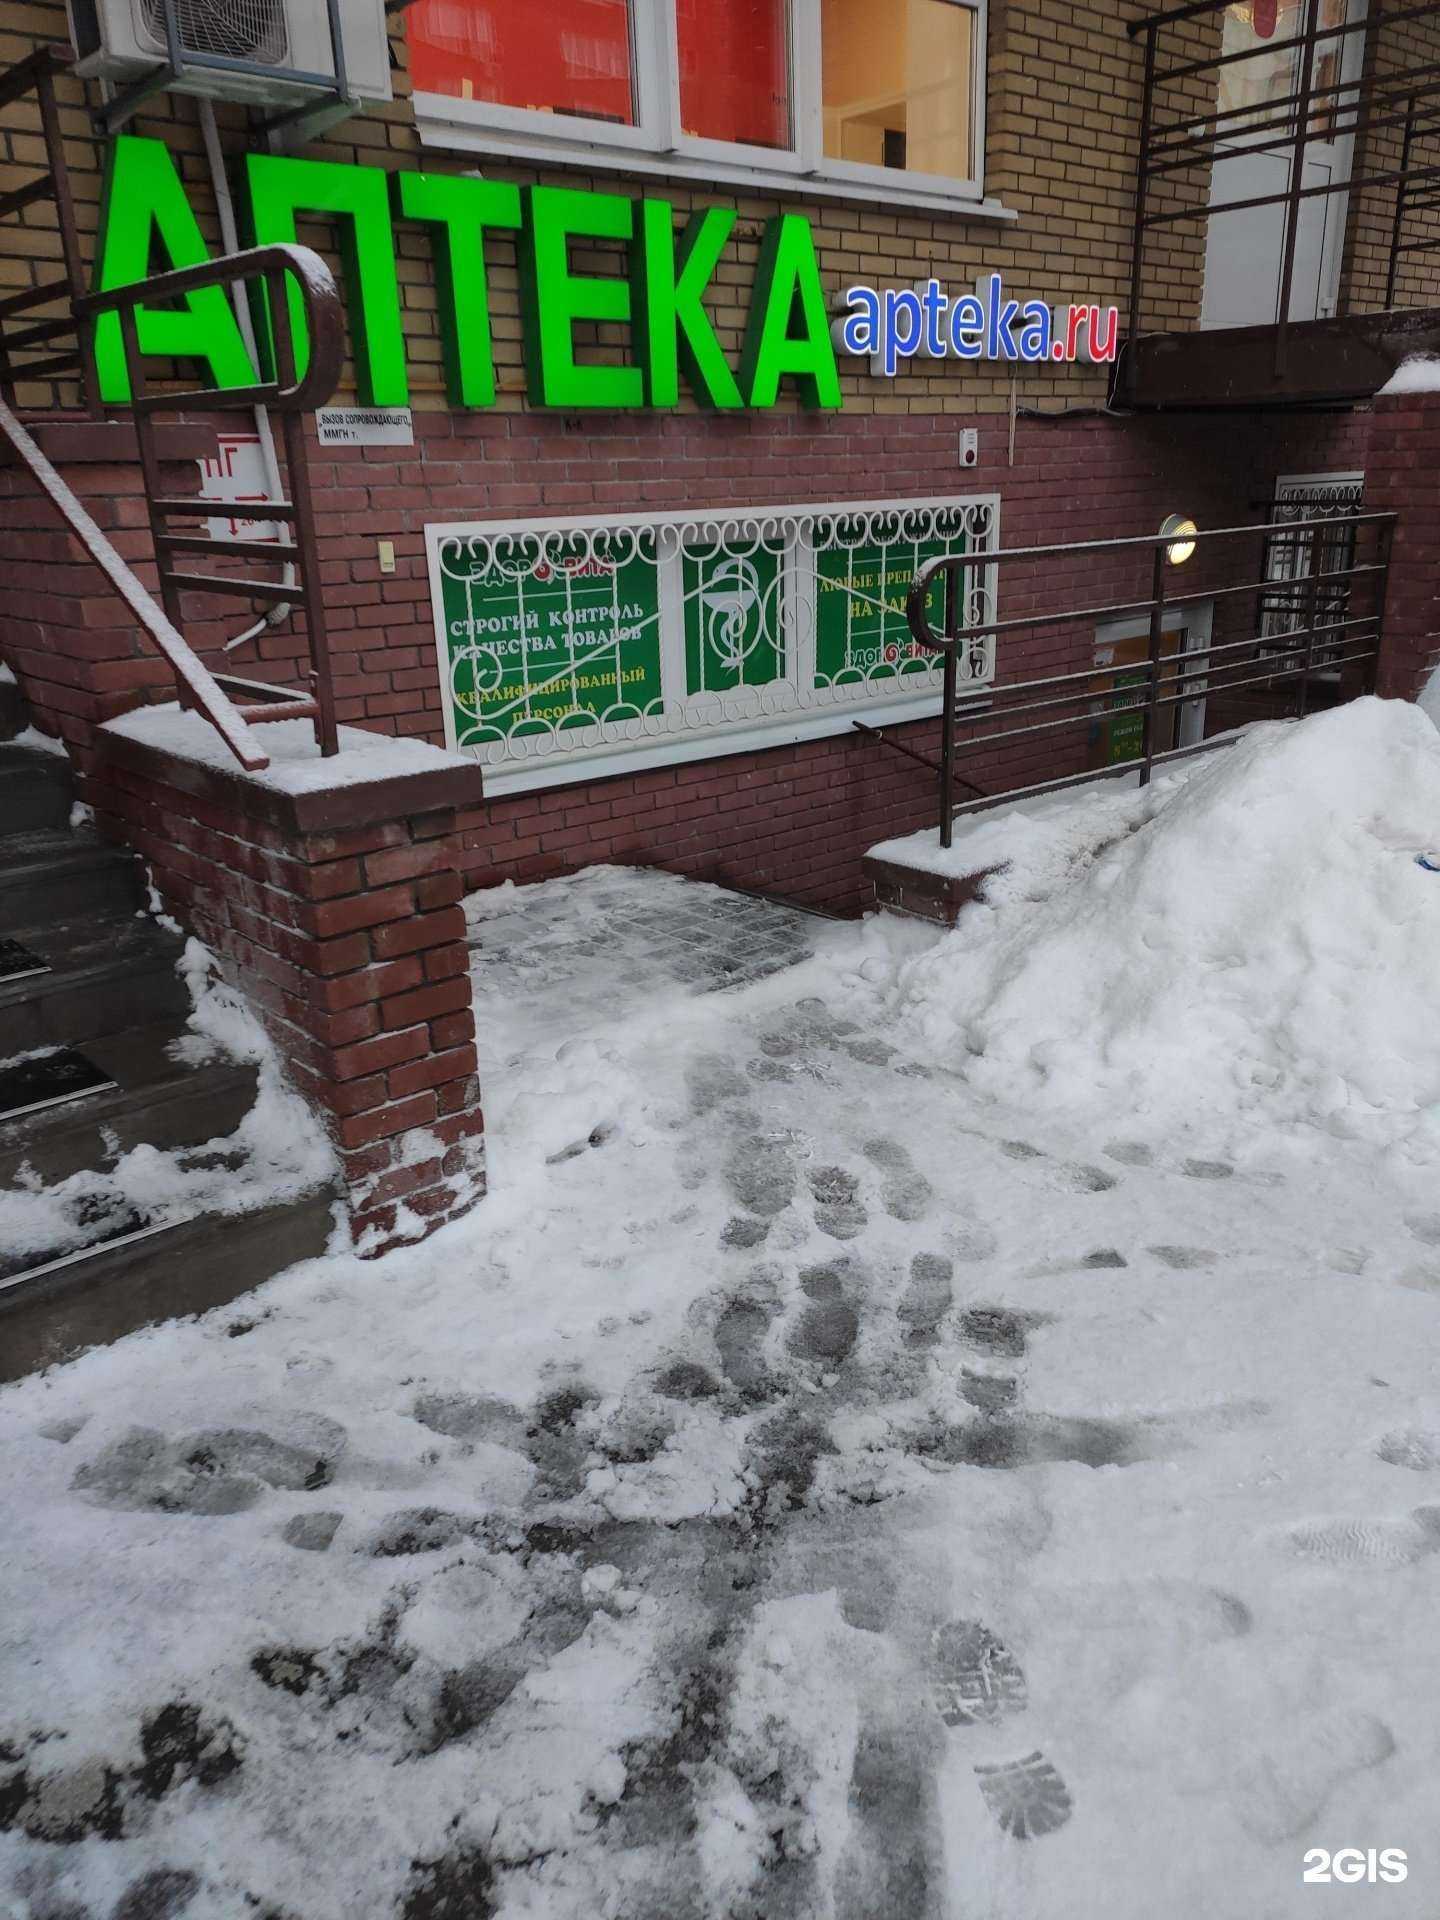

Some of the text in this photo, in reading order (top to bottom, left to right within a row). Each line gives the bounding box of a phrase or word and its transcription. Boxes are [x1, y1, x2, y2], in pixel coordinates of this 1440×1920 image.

[93, 135, 843, 415] АПТЕКА
[842, 273, 1119, 377] apteka.ru
[450, 603, 645, 637] СТРОГИЙ КОНТРОЛЬ
[849, 600, 874, 618] НА
